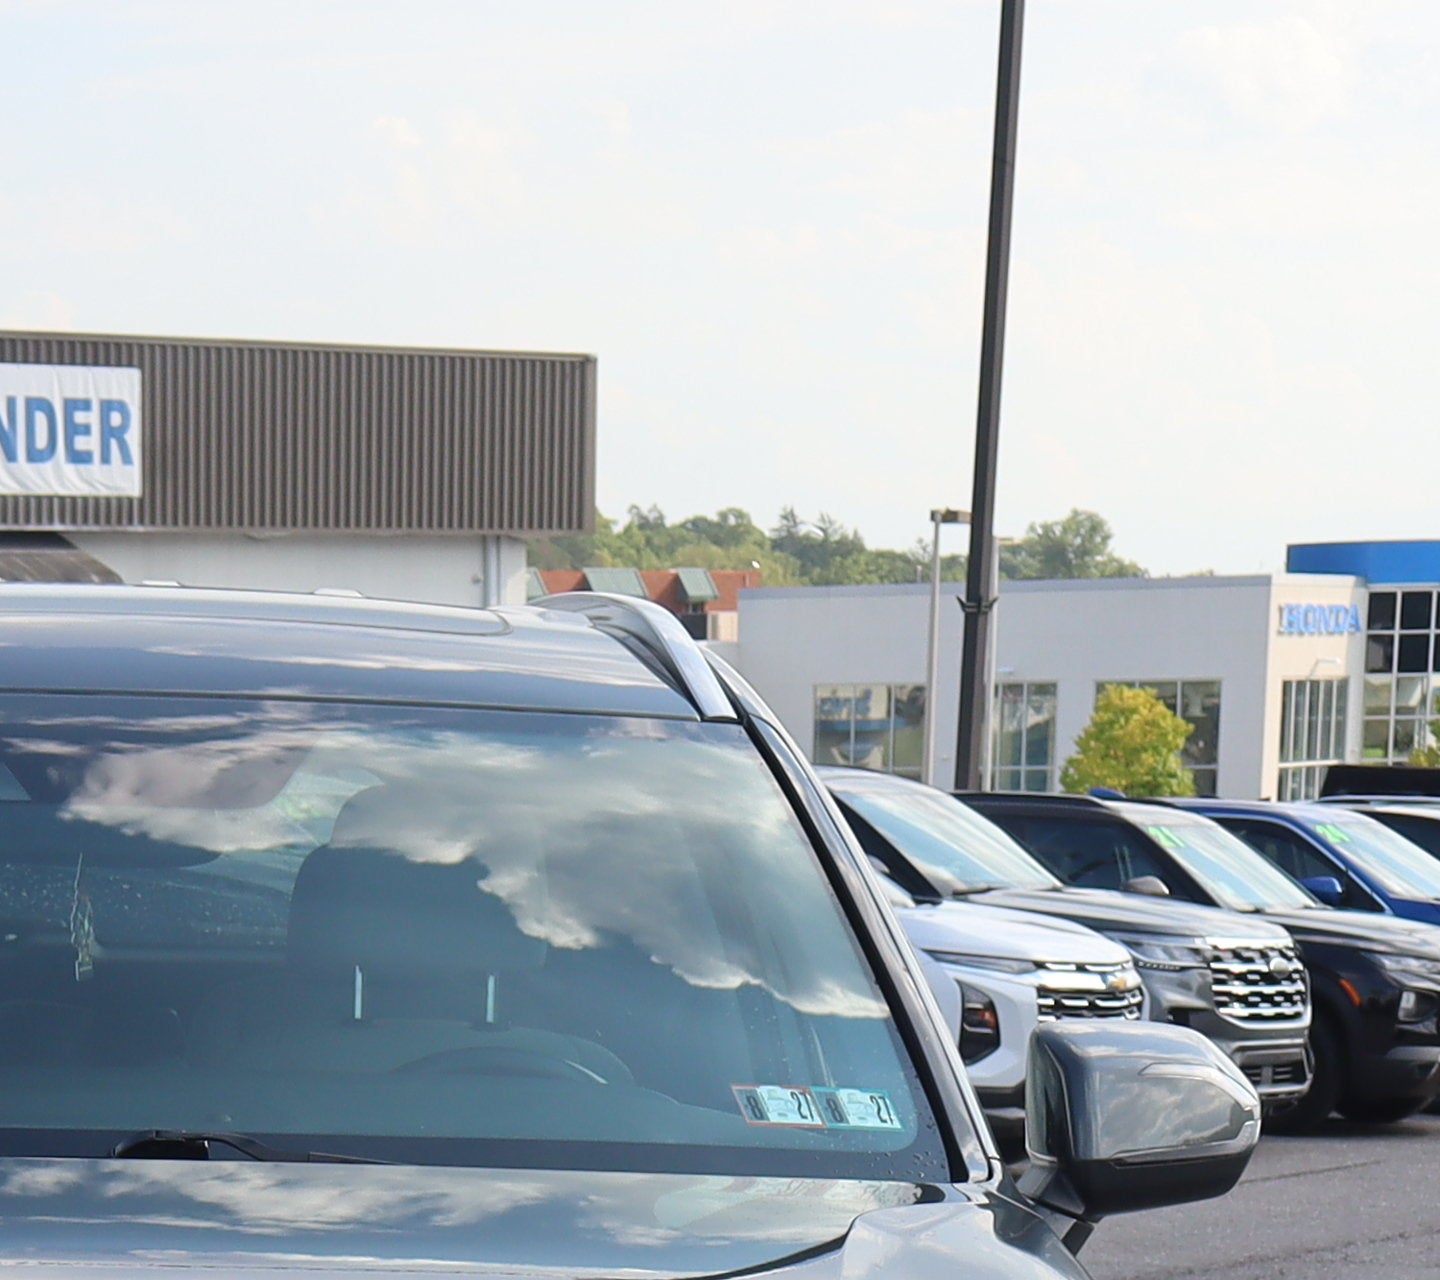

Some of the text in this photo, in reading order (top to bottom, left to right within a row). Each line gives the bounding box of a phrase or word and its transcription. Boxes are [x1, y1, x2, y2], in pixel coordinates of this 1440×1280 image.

[1279, 603, 1362, 635] HONDA
[746, 1090, 815, 1122] 8 27
[825, 1094, 895, 1126] 8 27
